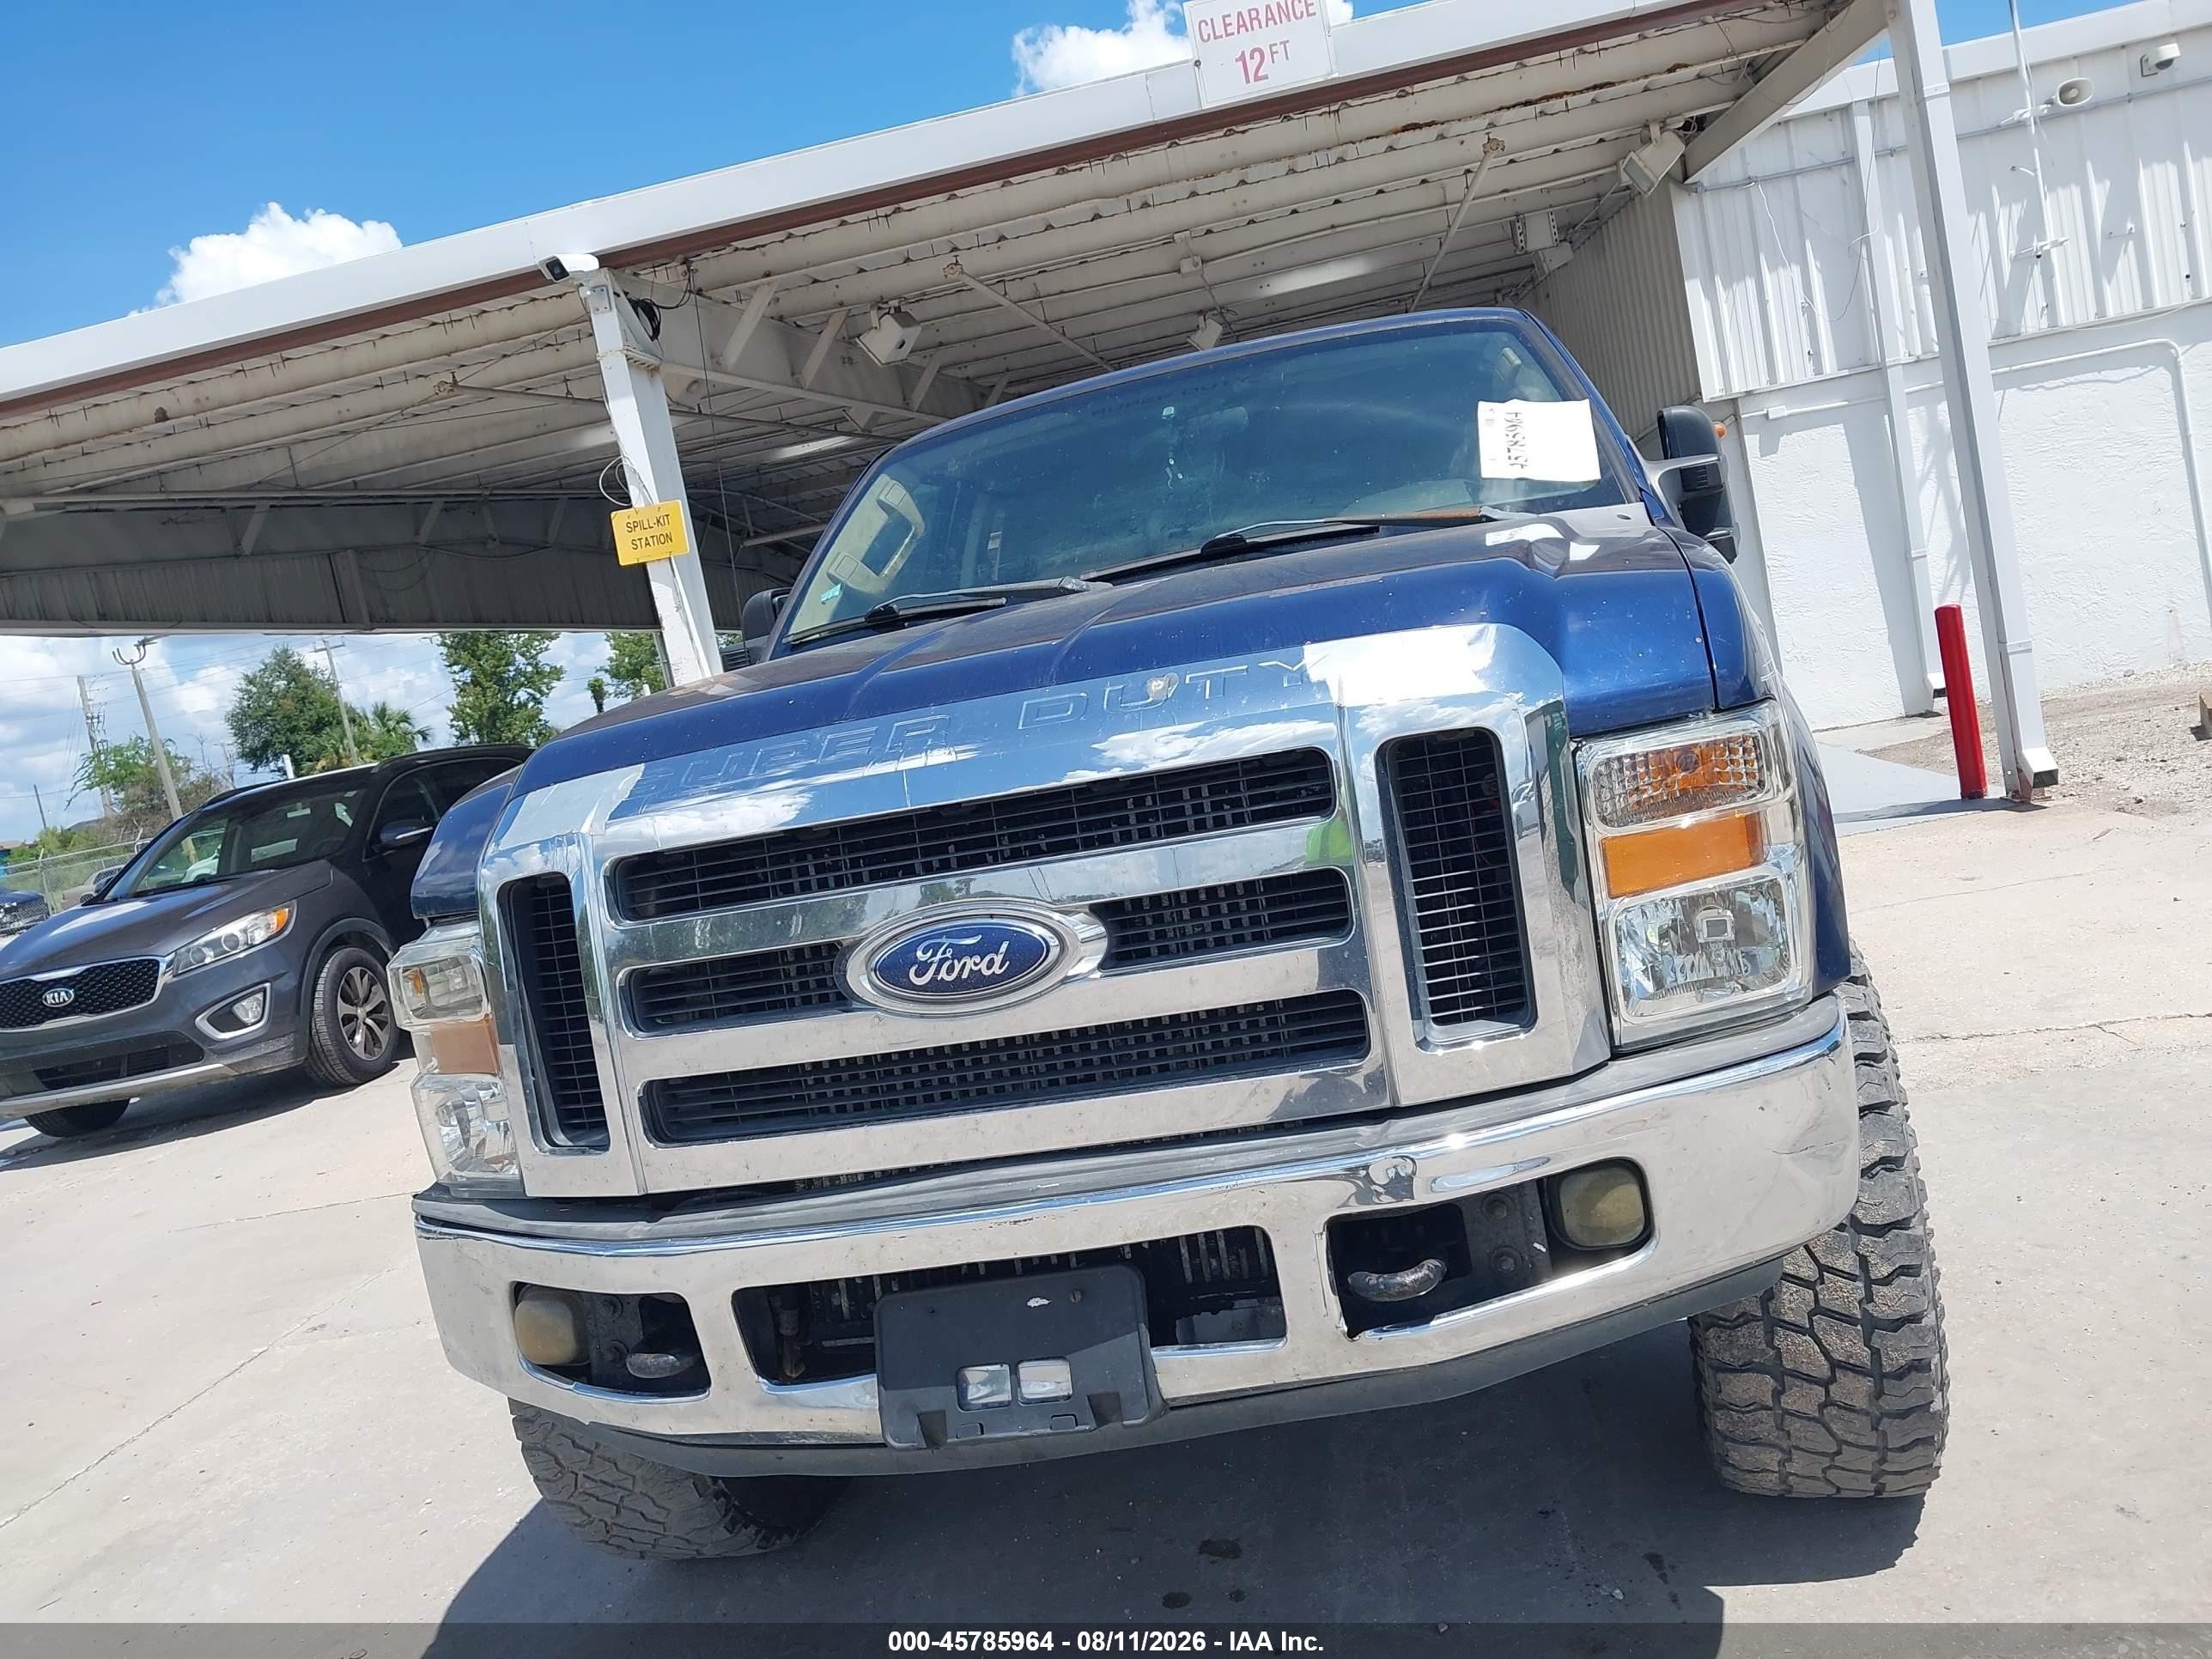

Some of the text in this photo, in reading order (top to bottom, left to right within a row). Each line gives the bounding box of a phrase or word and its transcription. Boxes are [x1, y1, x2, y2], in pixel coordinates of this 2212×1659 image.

[1198, 0, 1316, 43] CLEARANCE
[1235, 40, 1291, 84] 12 FT
[625, 514, 671, 533] SPILL-KIT
[631, 531, 673, 550] STATION
[624, 654, 1331, 800] SUPER DUTY
[908, 933, 1010, 986] Ford
[46, 991, 70, 1005] KIA
